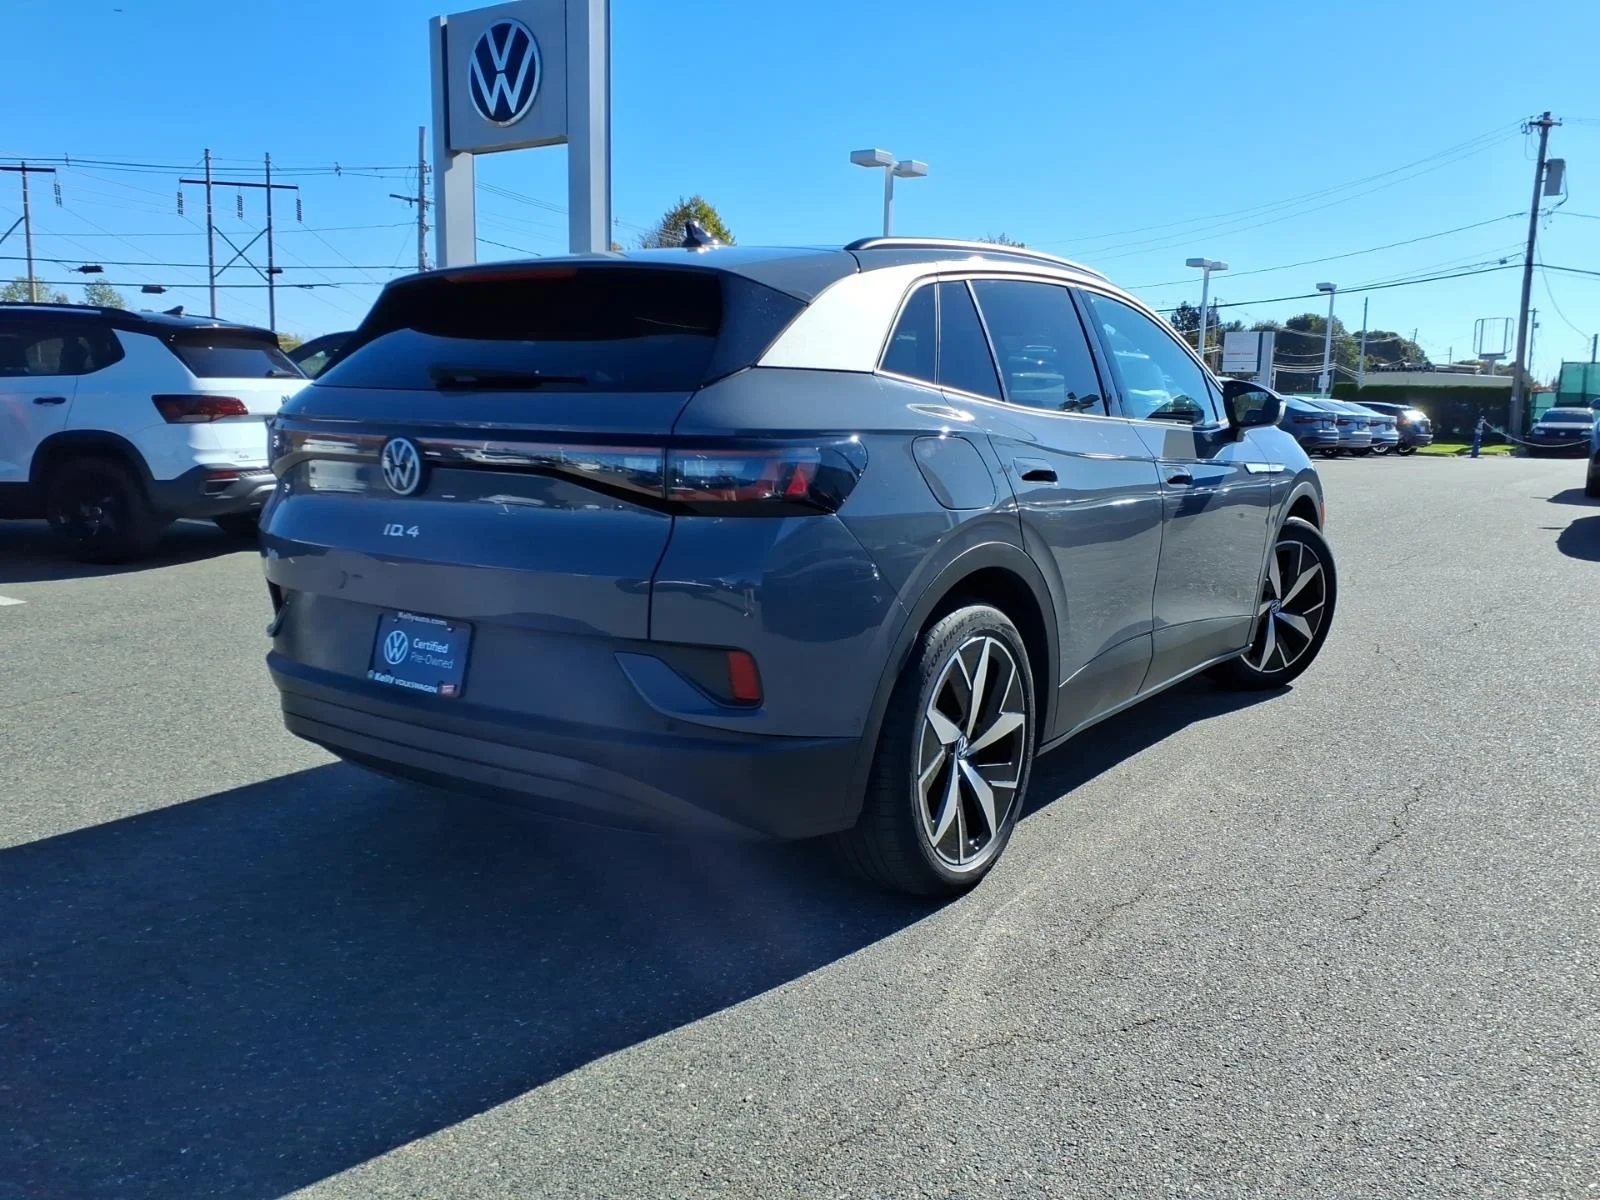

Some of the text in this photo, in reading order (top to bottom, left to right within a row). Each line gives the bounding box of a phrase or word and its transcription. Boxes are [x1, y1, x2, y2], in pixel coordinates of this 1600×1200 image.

[468, 17, 541, 127] VW
[381, 437, 420, 495] VW
[410, 651, 454, 669] Pre-Owned
[412, 638, 449, 654] Certified
